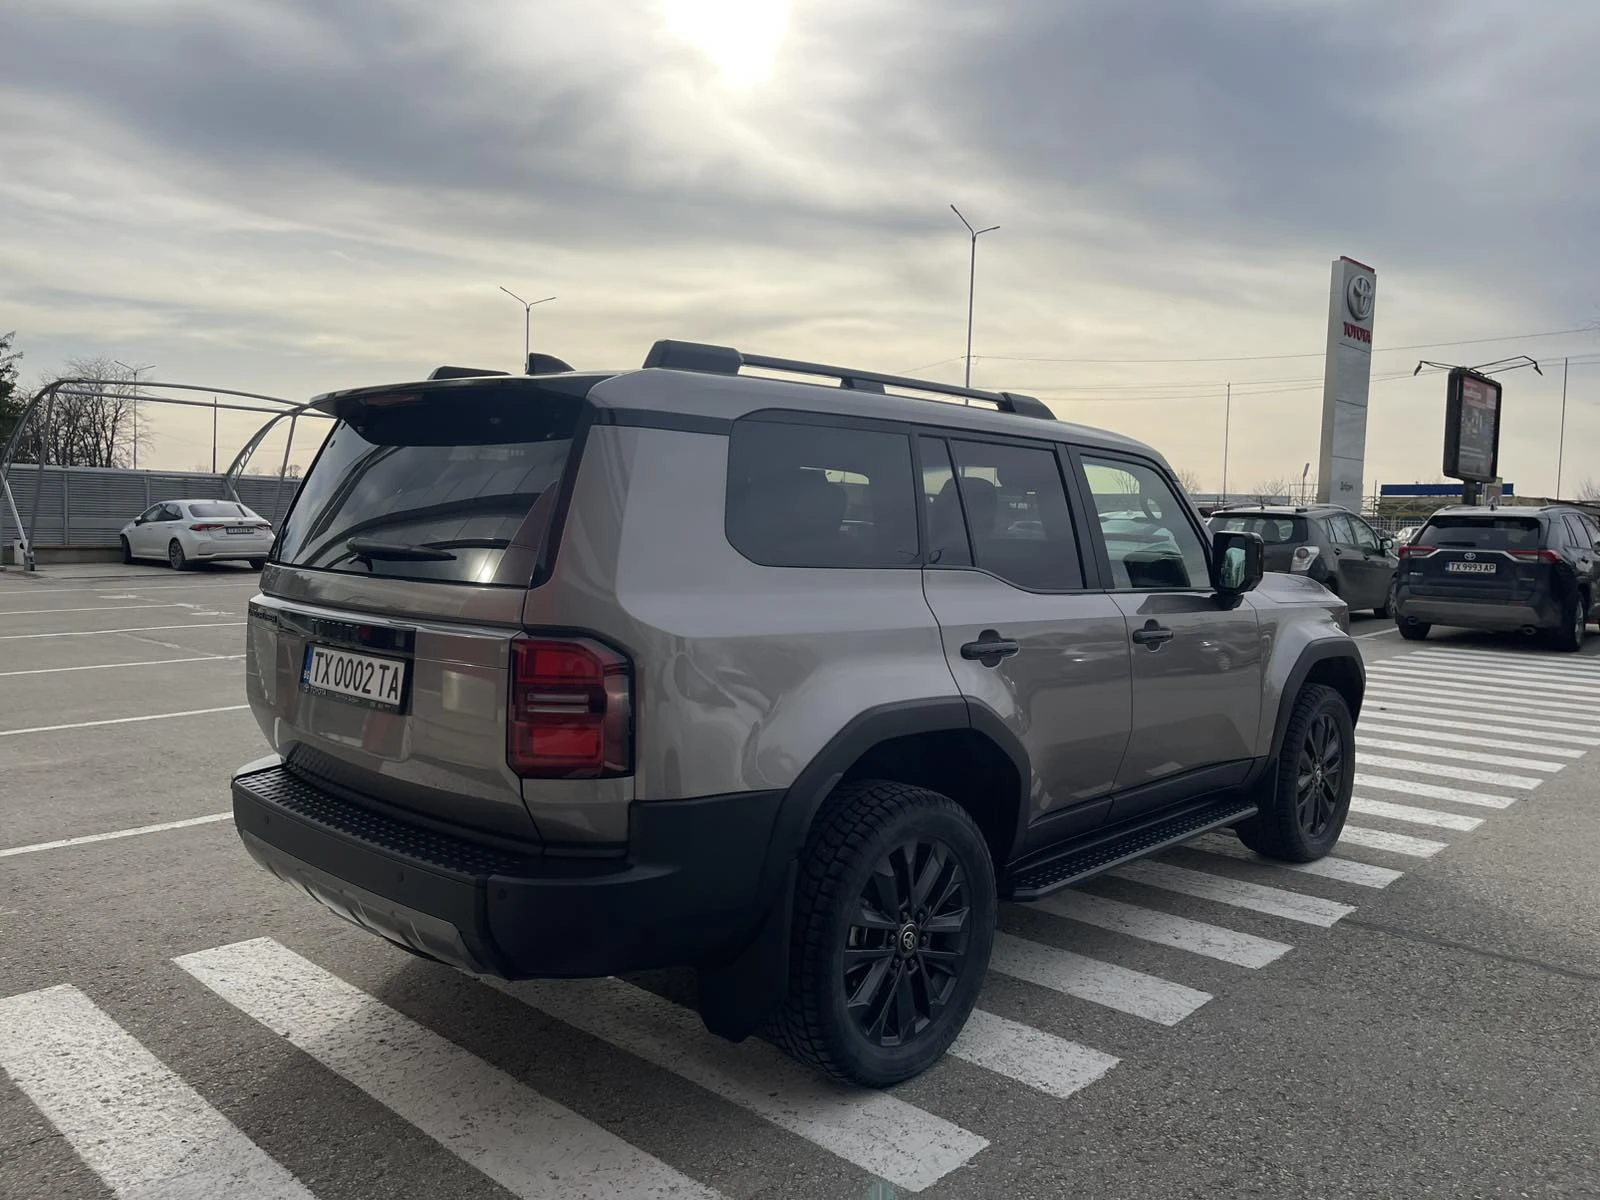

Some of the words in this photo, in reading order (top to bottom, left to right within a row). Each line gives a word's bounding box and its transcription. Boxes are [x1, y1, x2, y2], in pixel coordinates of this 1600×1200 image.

[1343, 321, 1371, 344] TOYOTA
[1462, 564, 1483, 573] 9993
[314, 651, 334, 685] TX
[334, 656, 375, 695] 0002
[378, 664, 399, 700] TA
